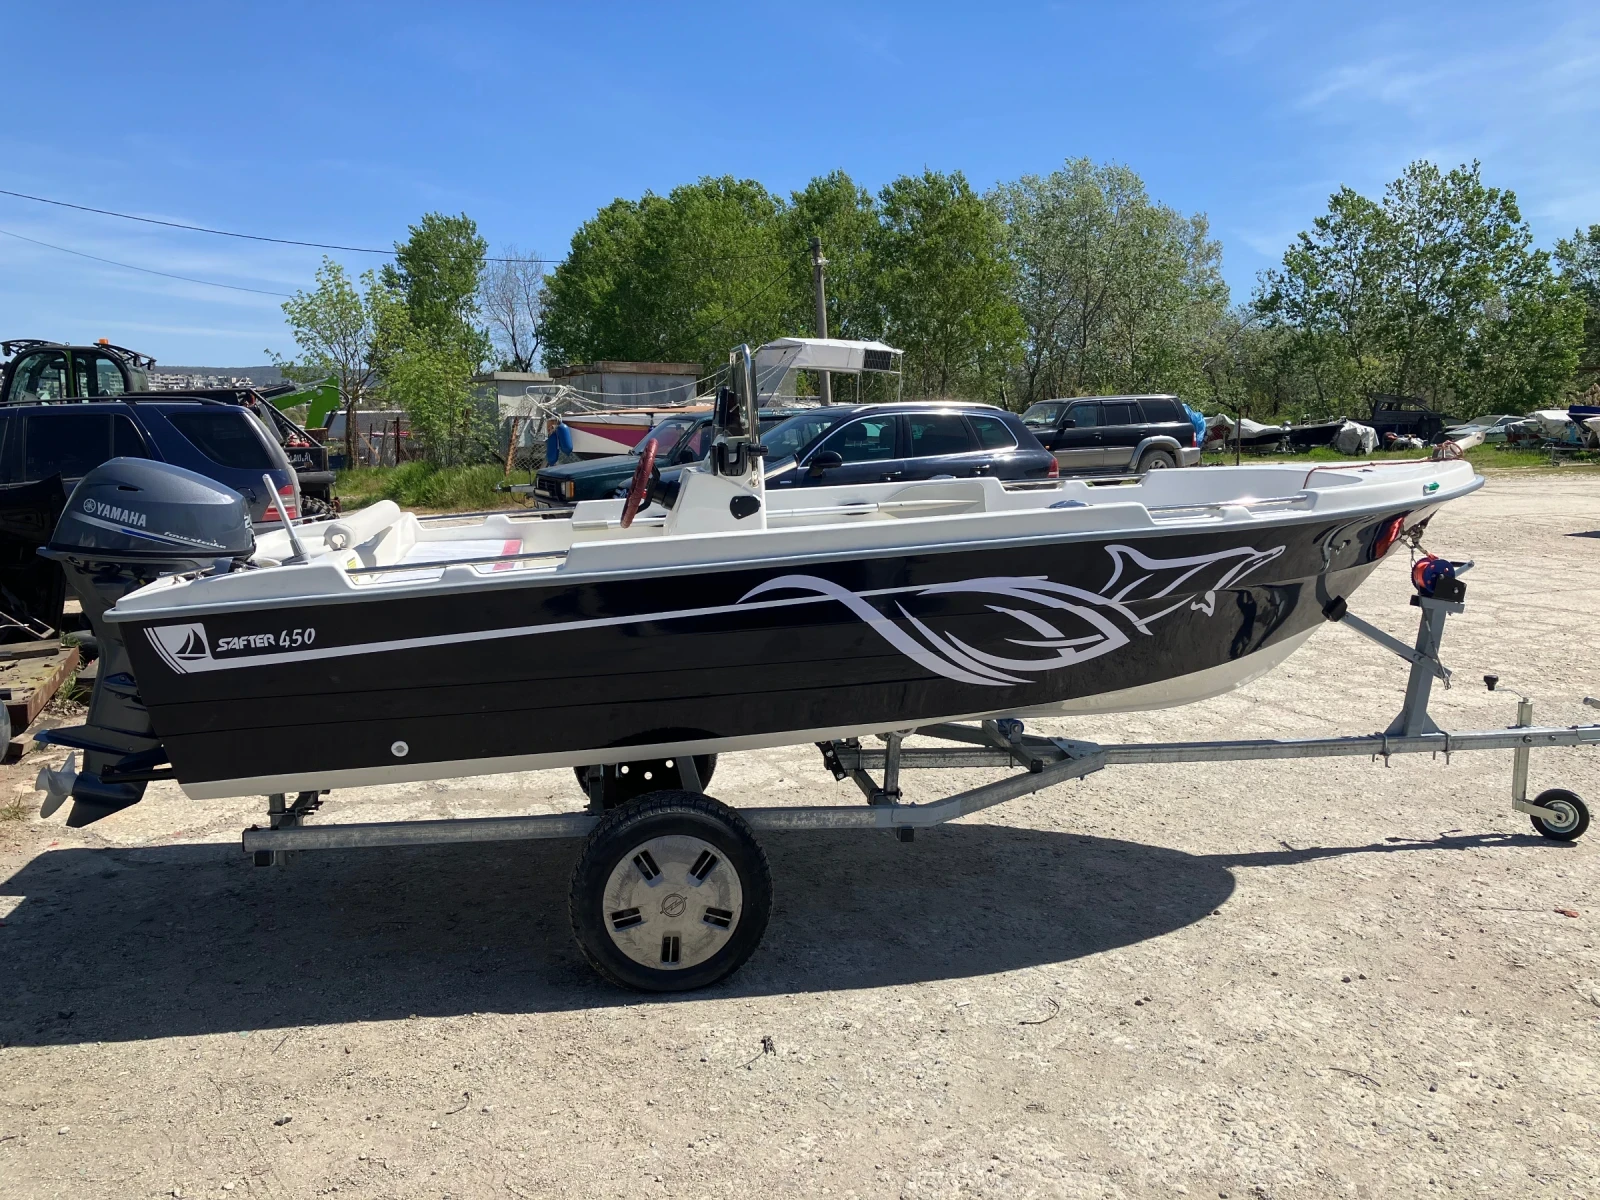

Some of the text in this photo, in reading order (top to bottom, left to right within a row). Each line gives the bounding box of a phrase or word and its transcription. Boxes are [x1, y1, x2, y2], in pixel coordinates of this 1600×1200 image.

[97, 502, 147, 527] YAMAHA
[216, 627, 316, 652] SAFTER 450
